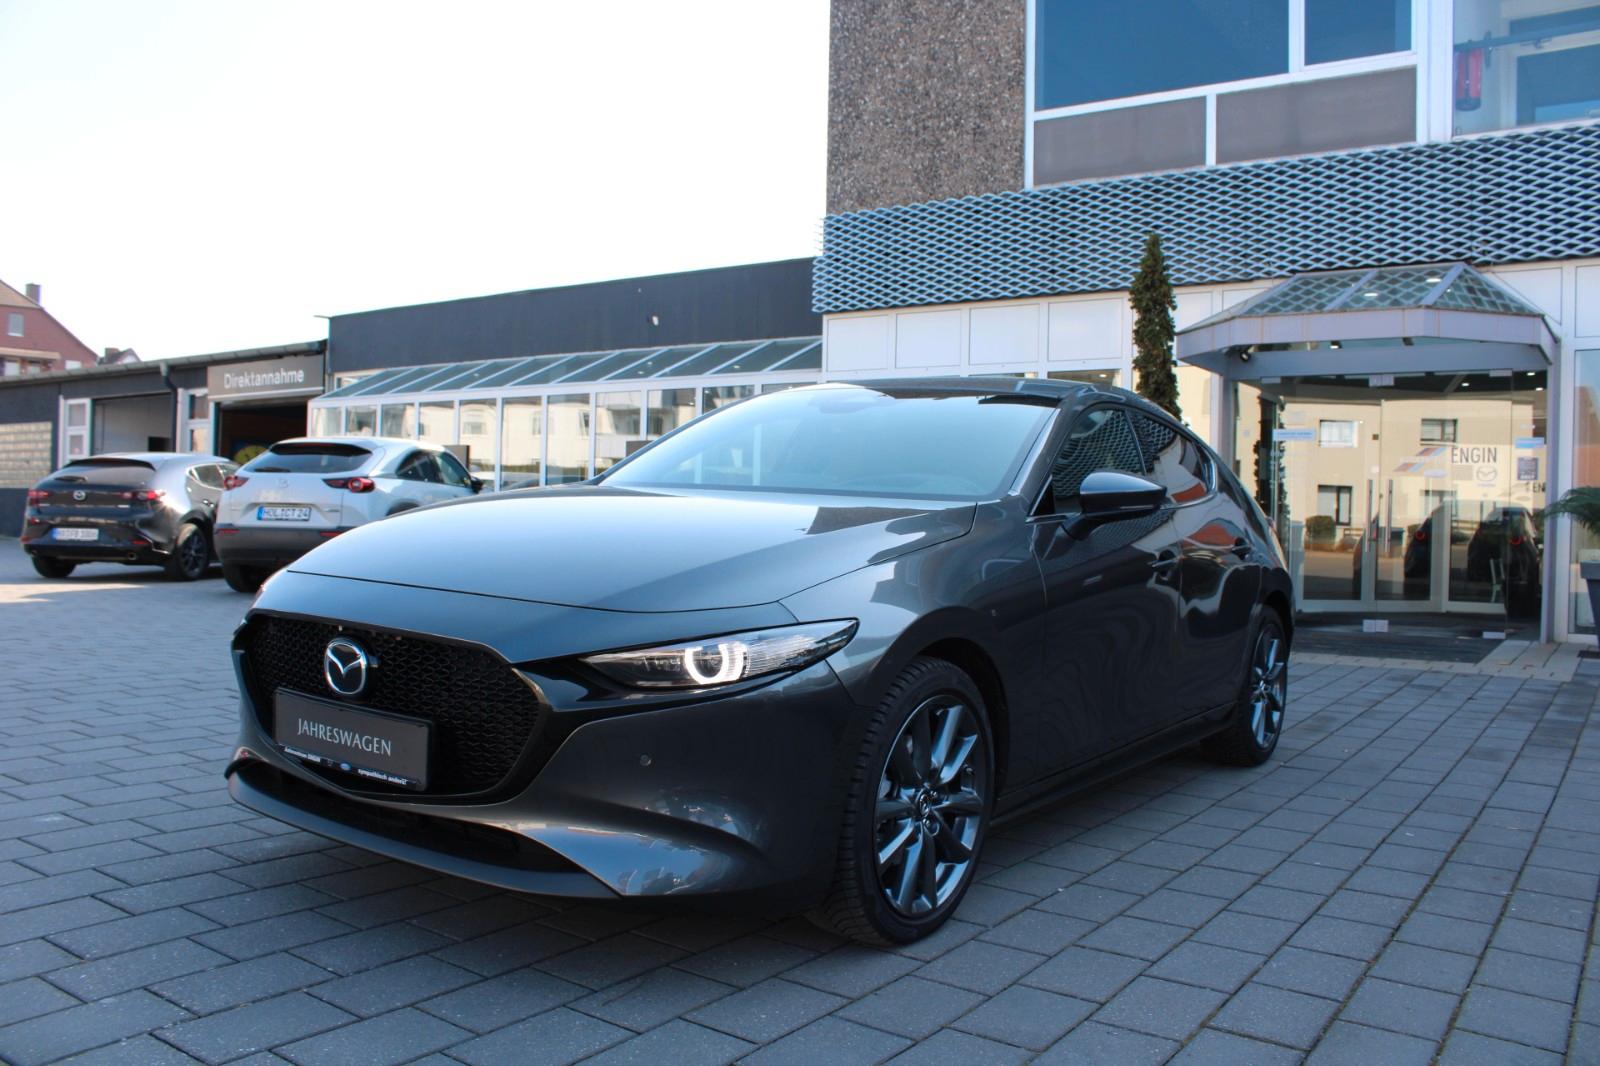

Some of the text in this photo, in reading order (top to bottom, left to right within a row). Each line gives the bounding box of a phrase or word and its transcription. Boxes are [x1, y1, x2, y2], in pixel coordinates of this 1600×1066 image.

[223, 367, 305, 389] Direktannahme
[1451, 447, 1497, 464] ENGIN
[297, 718, 392, 756] JAHRESWAGEN
